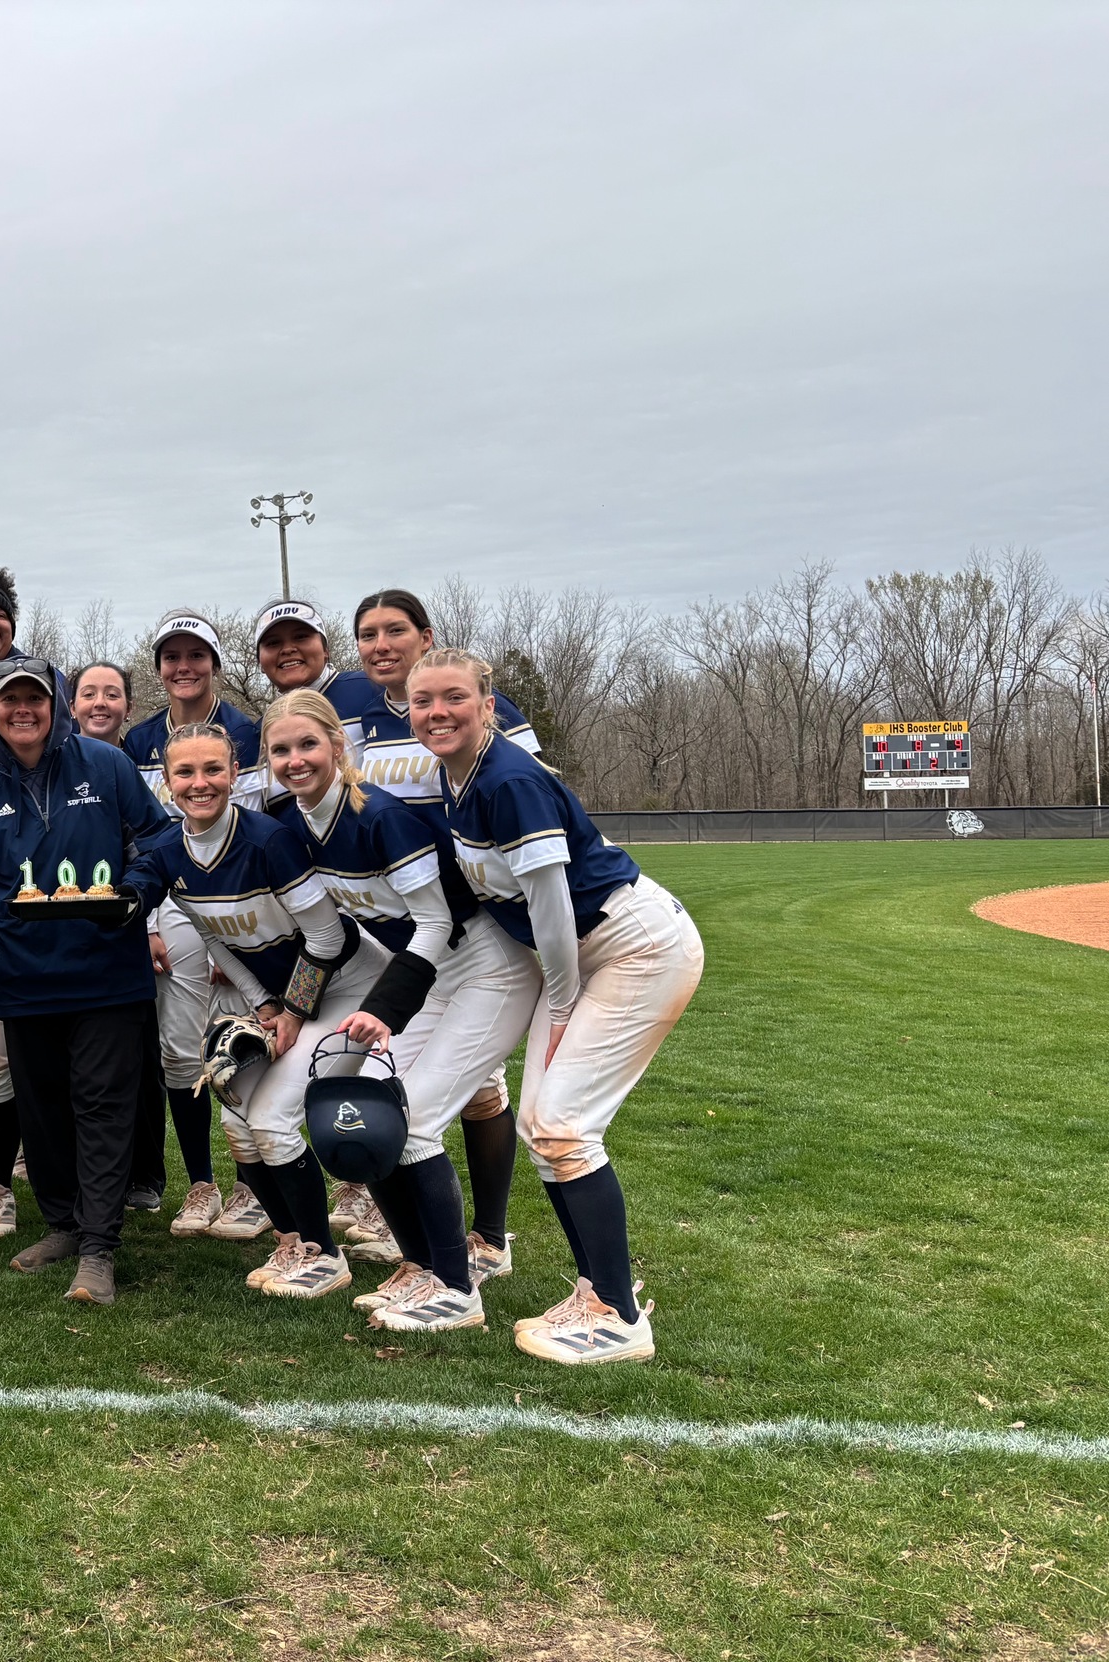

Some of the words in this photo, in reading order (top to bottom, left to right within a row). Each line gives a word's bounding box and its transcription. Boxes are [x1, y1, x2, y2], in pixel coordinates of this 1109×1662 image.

[271, 607, 299, 620] INDY
[171, 621, 199, 630] INDY
[889, 723, 905, 733] IHS
[907, 723, 941, 733] Booster
[943, 722, 963, 732] Club
[877, 741, 888, 752] 10
[955, 739, 962, 751] 9
[930, 758, 938, 770] 2
[364, 756, 432, 785] INDY
[200, 910, 258, 937] NDY
